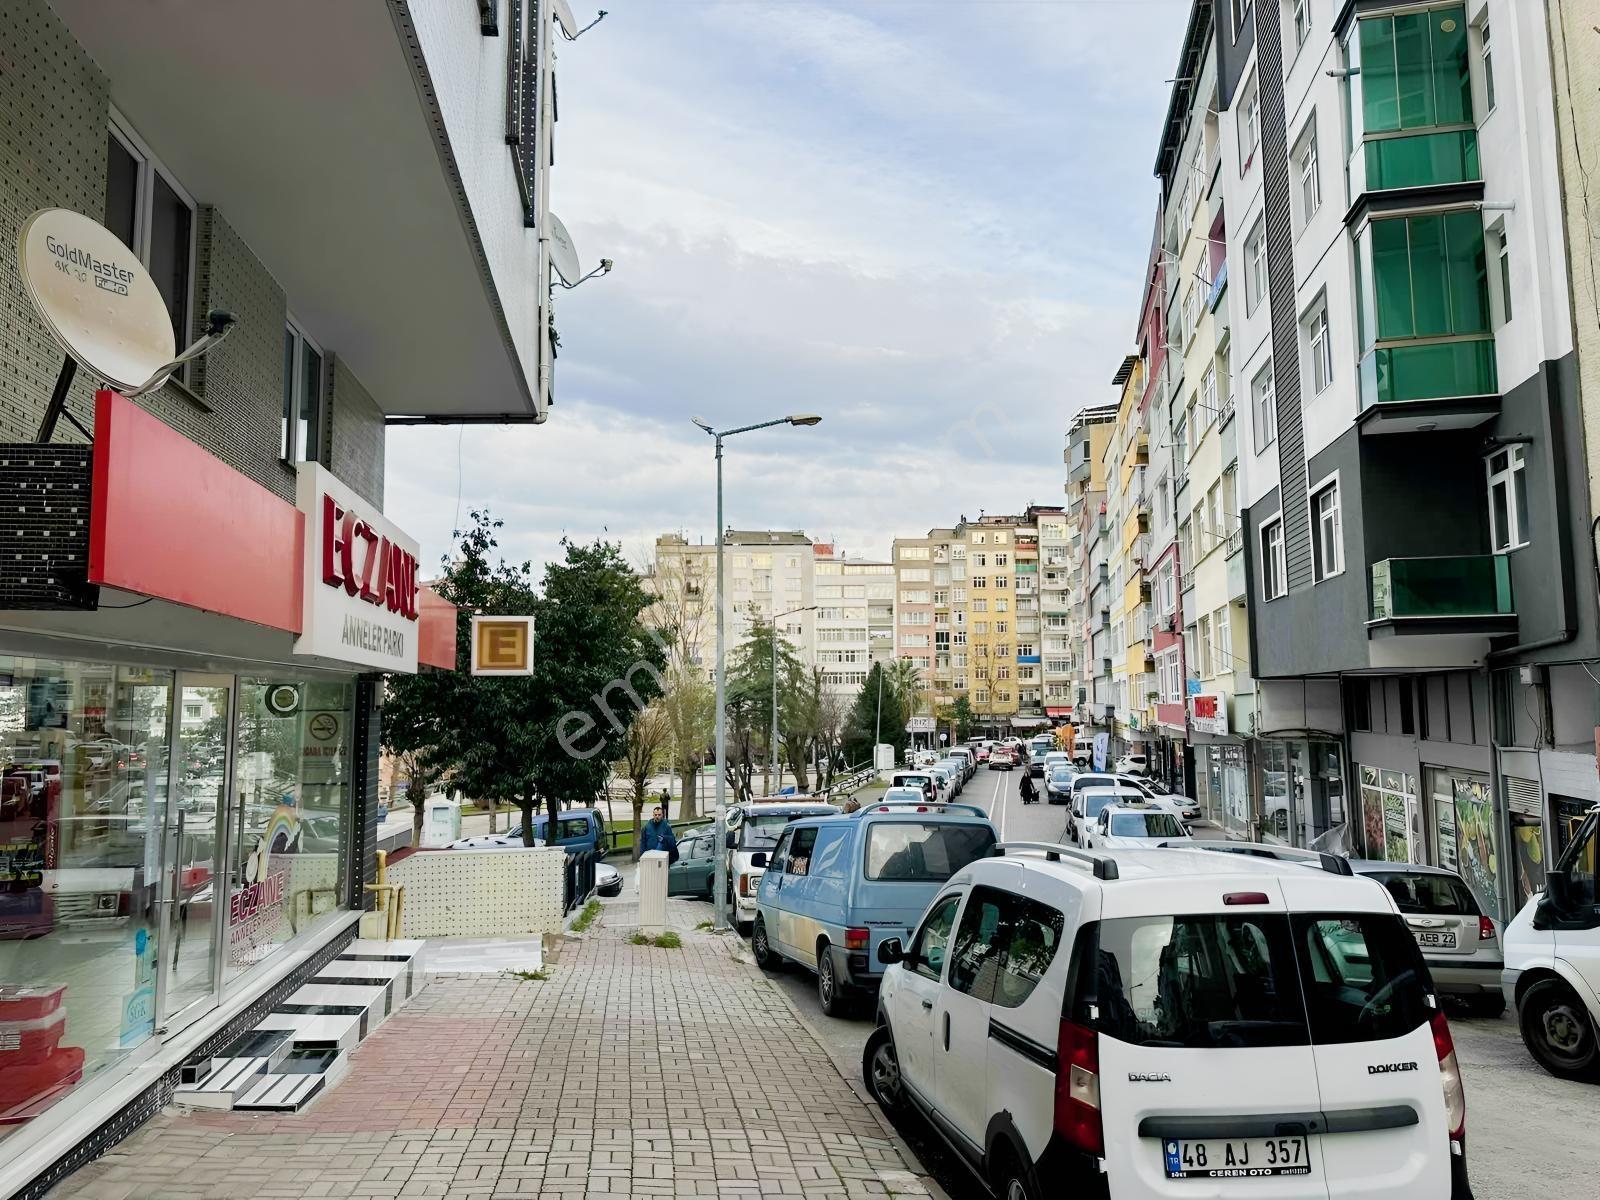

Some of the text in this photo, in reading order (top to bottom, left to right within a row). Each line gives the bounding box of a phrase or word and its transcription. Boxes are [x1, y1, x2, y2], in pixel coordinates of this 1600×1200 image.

[46, 235, 134, 284] GoldMaster
[322, 493, 420, 621] ECZANE
[341, 614, 404, 659] ANNELER PARKI
[489, 629, 517, 663] E
[229, 871, 284, 928] ECZANE
[1419, 933, 1439, 943] AEB
[1442, 934, 1454, 944] 22
[1128, 1072, 1171, 1082] DACIA
[1367, 1061, 1418, 1075] DOKKER
[1170, 1157, 1179, 1165] TR
[1182, 1139, 1301, 1167] 48 AJ 357
[1209, 1169, 1247, 1177] CEREN
[1249, 1168, 1272, 1176] OTO
